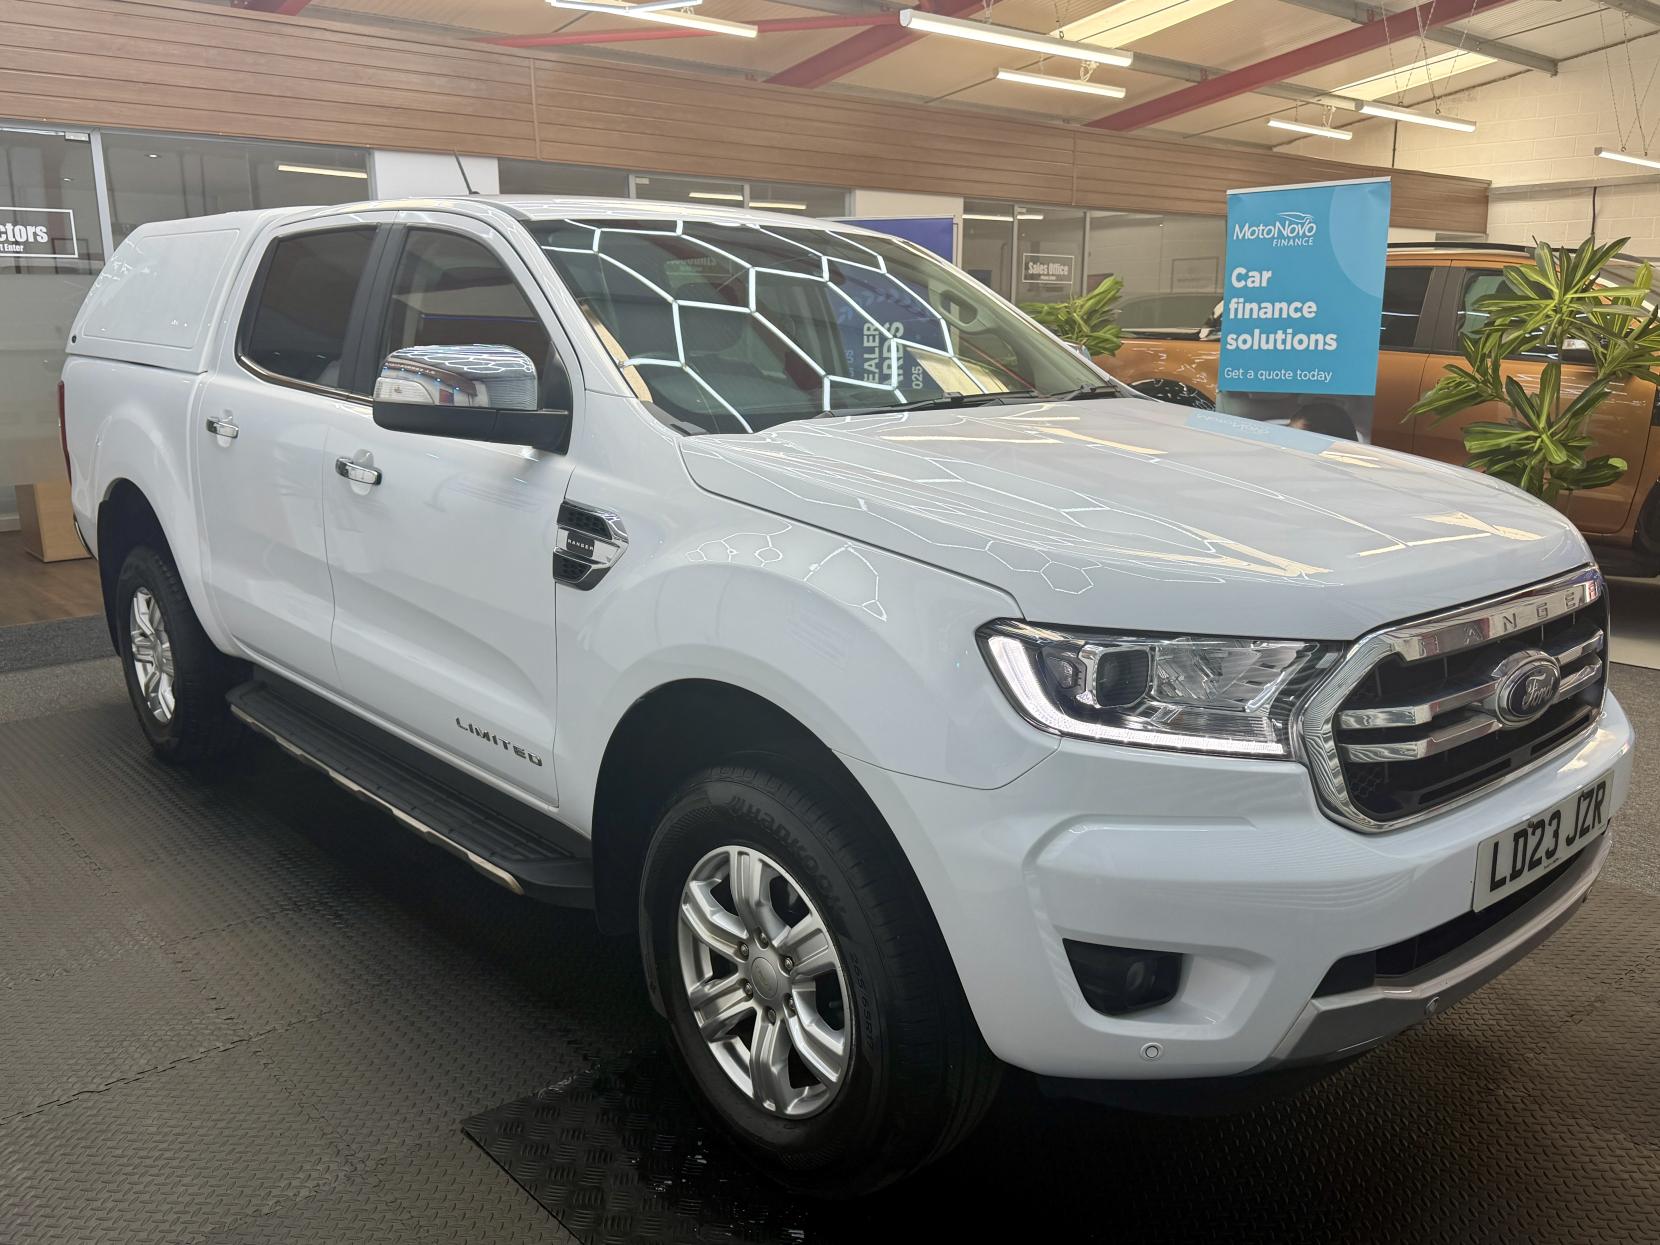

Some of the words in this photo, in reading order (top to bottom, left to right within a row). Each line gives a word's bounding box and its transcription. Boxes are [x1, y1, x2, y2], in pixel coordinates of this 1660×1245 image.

[1233, 219, 1317, 240] MotoNovo
[4, 244, 24, 252] Enter
[1272, 237, 1314, 247] FINANCE
[1028, 262, 1048, 274] Sales
[1048, 263, 1069, 275] Office
[1231, 267, 1272, 288] Car
[1229, 298, 1318, 319] finance
[1226, 329, 1338, 350] solutions
[911, 366, 923, 390] 025
[1224, 368, 1245, 379] Get
[1246, 370, 1254, 379] a
[1257, 369, 1293, 381] quote
[1297, 368, 1333, 383] today
[567, 539, 594, 550] RANGER
[1521, 673, 1554, 708] Ford
[455, 717, 543, 767] LIMITED
[1489, 809, 1562, 893] LD23
[1565, 780, 1607, 847] JZR
